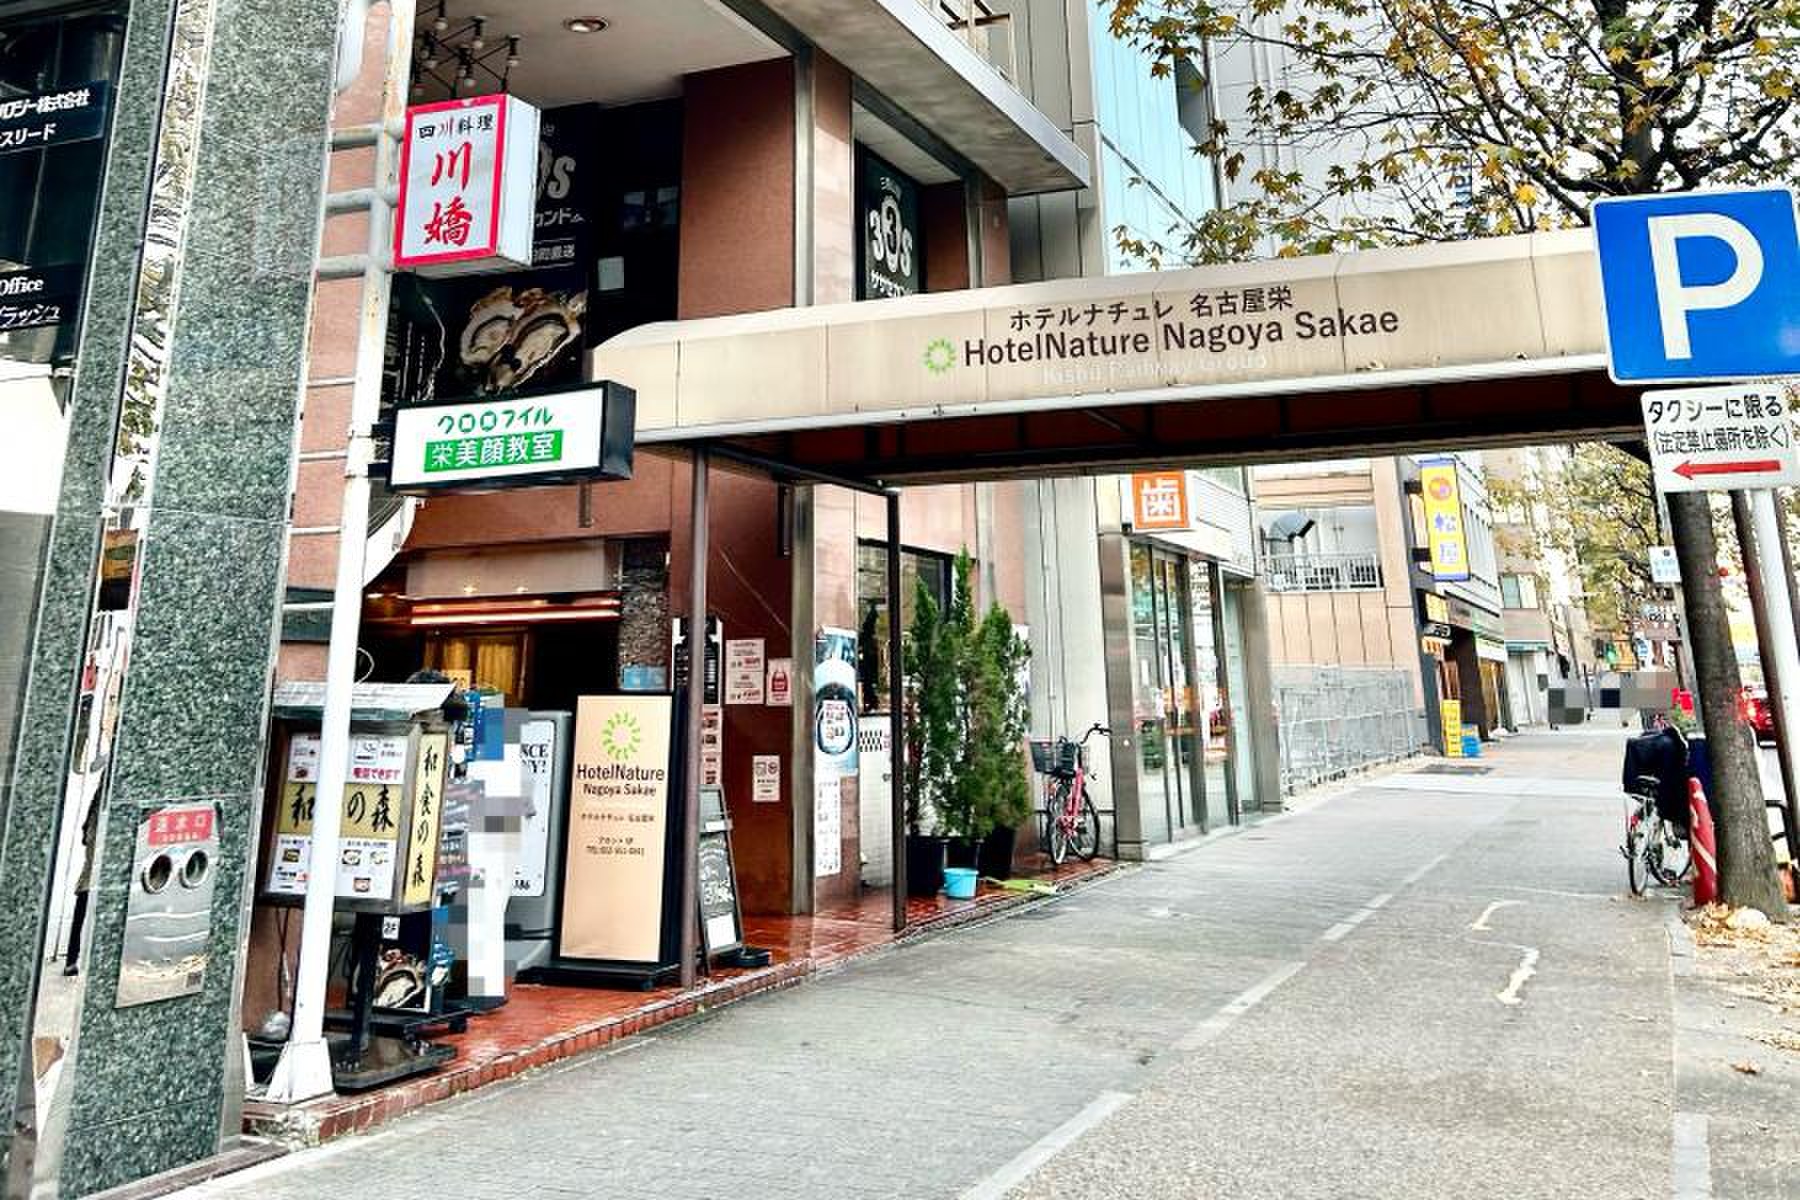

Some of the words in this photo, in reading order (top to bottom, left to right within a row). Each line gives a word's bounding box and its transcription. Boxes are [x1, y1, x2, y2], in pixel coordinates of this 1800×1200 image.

[0, 123, 57, 147] スリード
[418, 113, 494, 139] 四川料理
[1648, 213, 1764, 360] P
[1010, 301, 1173, 332] ホテルナチュレ
[1190, 285, 1293, 319] 名古屋栄
[964, 331, 1150, 367] HotelNature
[1163, 320, 1283, 353] Nagoya
[1295, 308, 1399, 339] Sakae
[1648, 394, 1783, 424] タクシーに限る
[431, 432, 555, 468] 栄美顔教室
[1142, 479, 1181, 521] 歯
[576, 763, 665, 781] HotelNature
